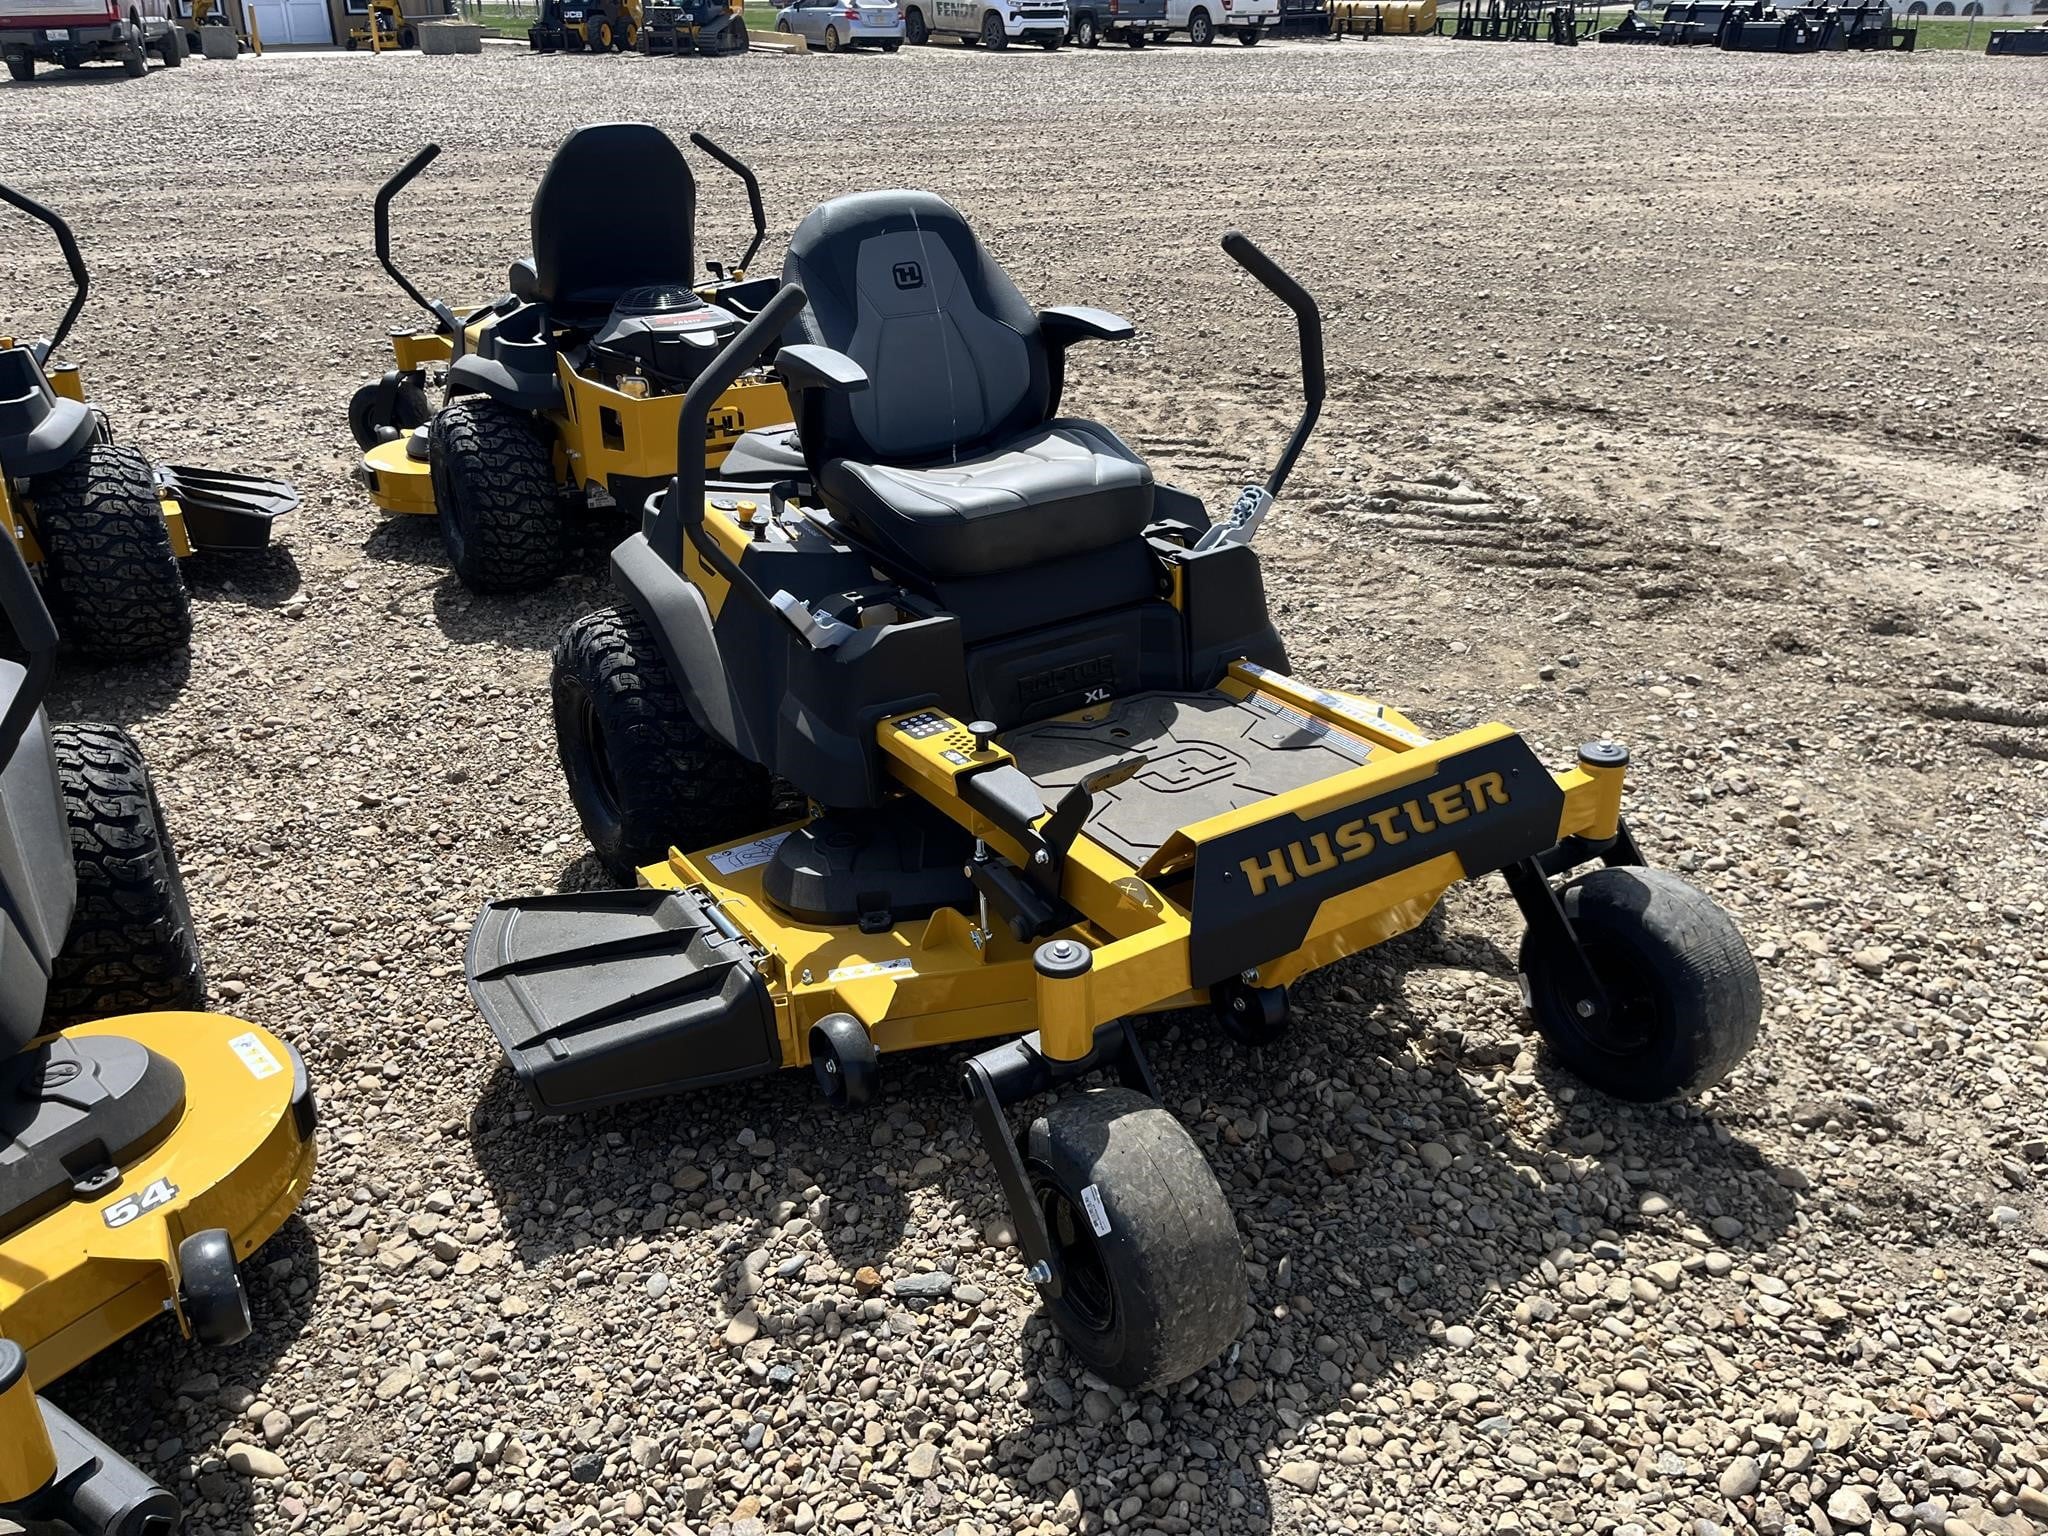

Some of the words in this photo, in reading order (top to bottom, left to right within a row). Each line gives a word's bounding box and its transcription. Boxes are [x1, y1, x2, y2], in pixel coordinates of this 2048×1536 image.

[936, 2, 978, 17] FENDT
[1085, 688, 1110, 704] XL
[1240, 772, 1510, 897] HUSTLER
[102, 1178, 179, 1228] 54
